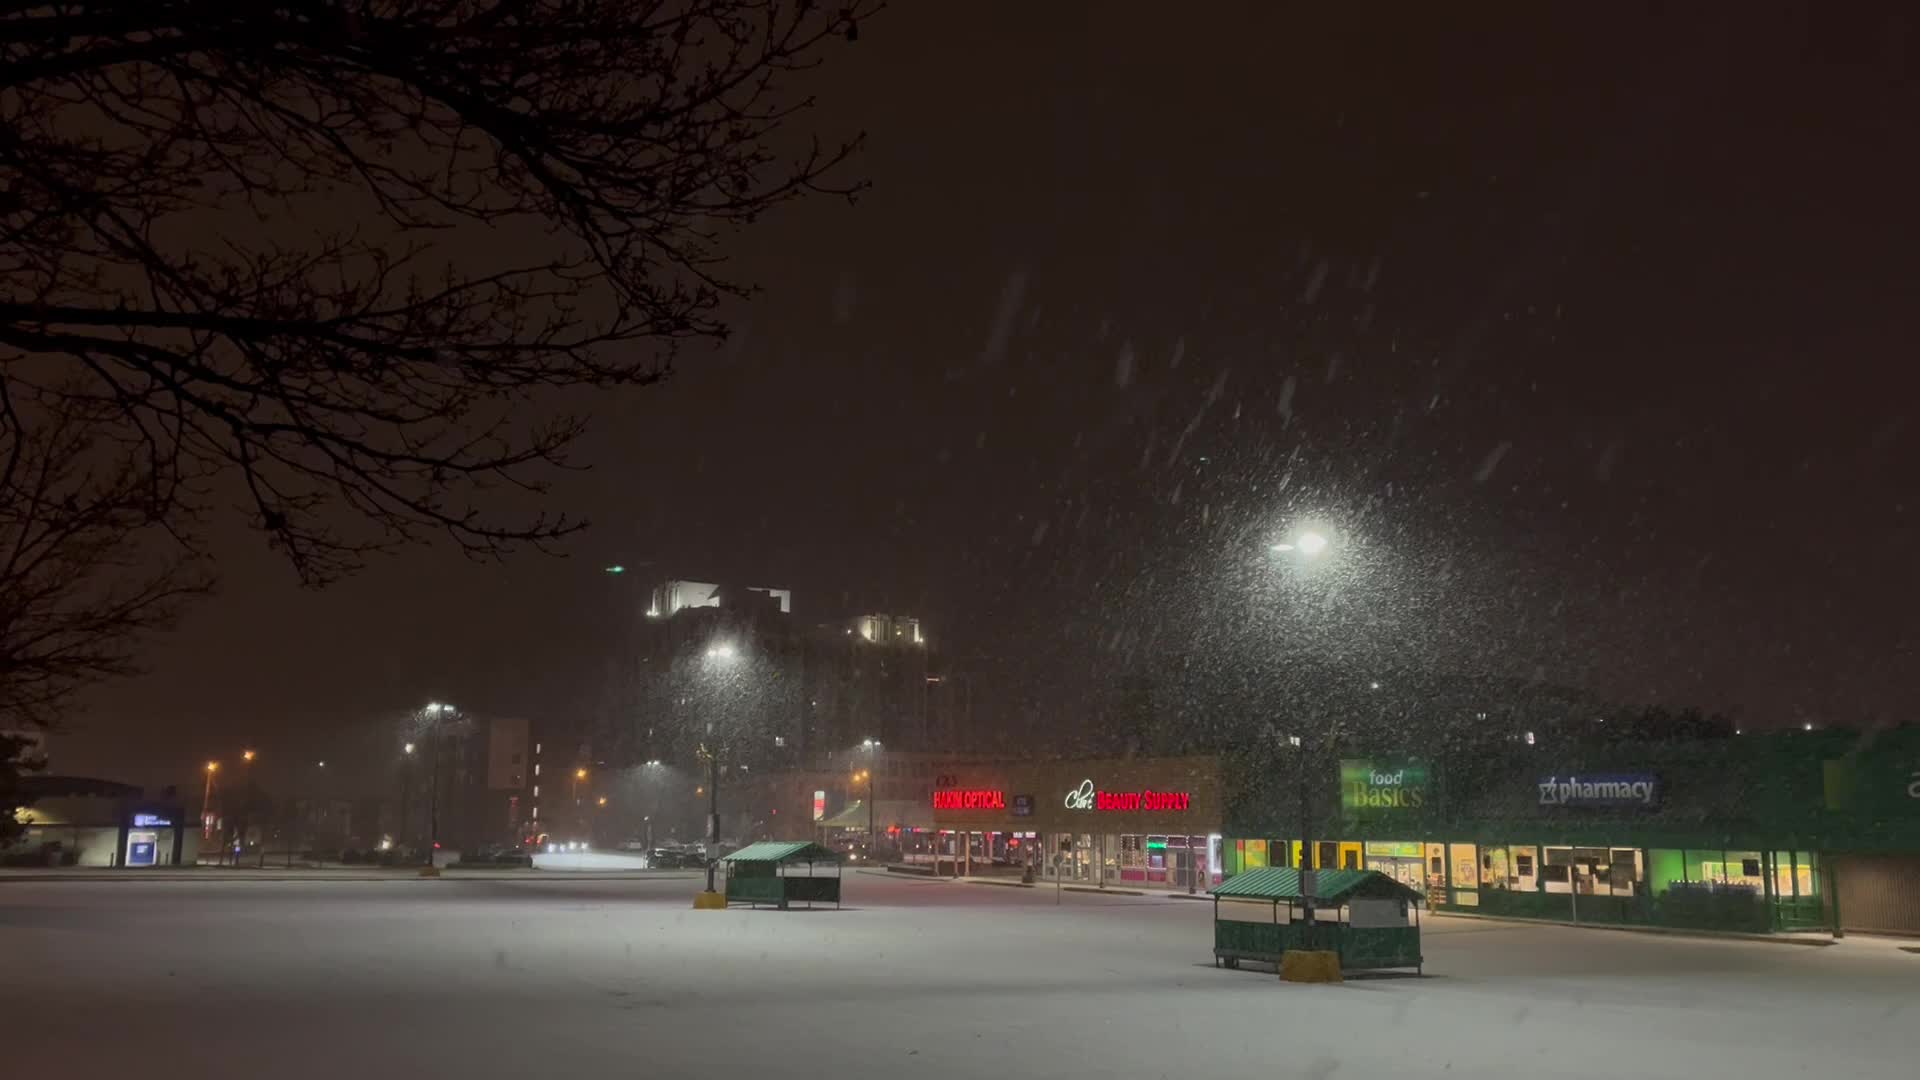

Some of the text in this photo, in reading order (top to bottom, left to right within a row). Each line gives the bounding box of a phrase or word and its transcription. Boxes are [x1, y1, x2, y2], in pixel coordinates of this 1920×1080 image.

[1369, 769, 1404, 785] food
[933, 791, 962, 809] HAKIM
[964, 791, 1005, 809] OPTICAL
[1097, 791, 1141, 810] BEAUTY
[1144, 790, 1190, 810] SUPPLY
[1353, 781, 1423, 808] Basics
[1560, 777, 1654, 804] pharmacy
